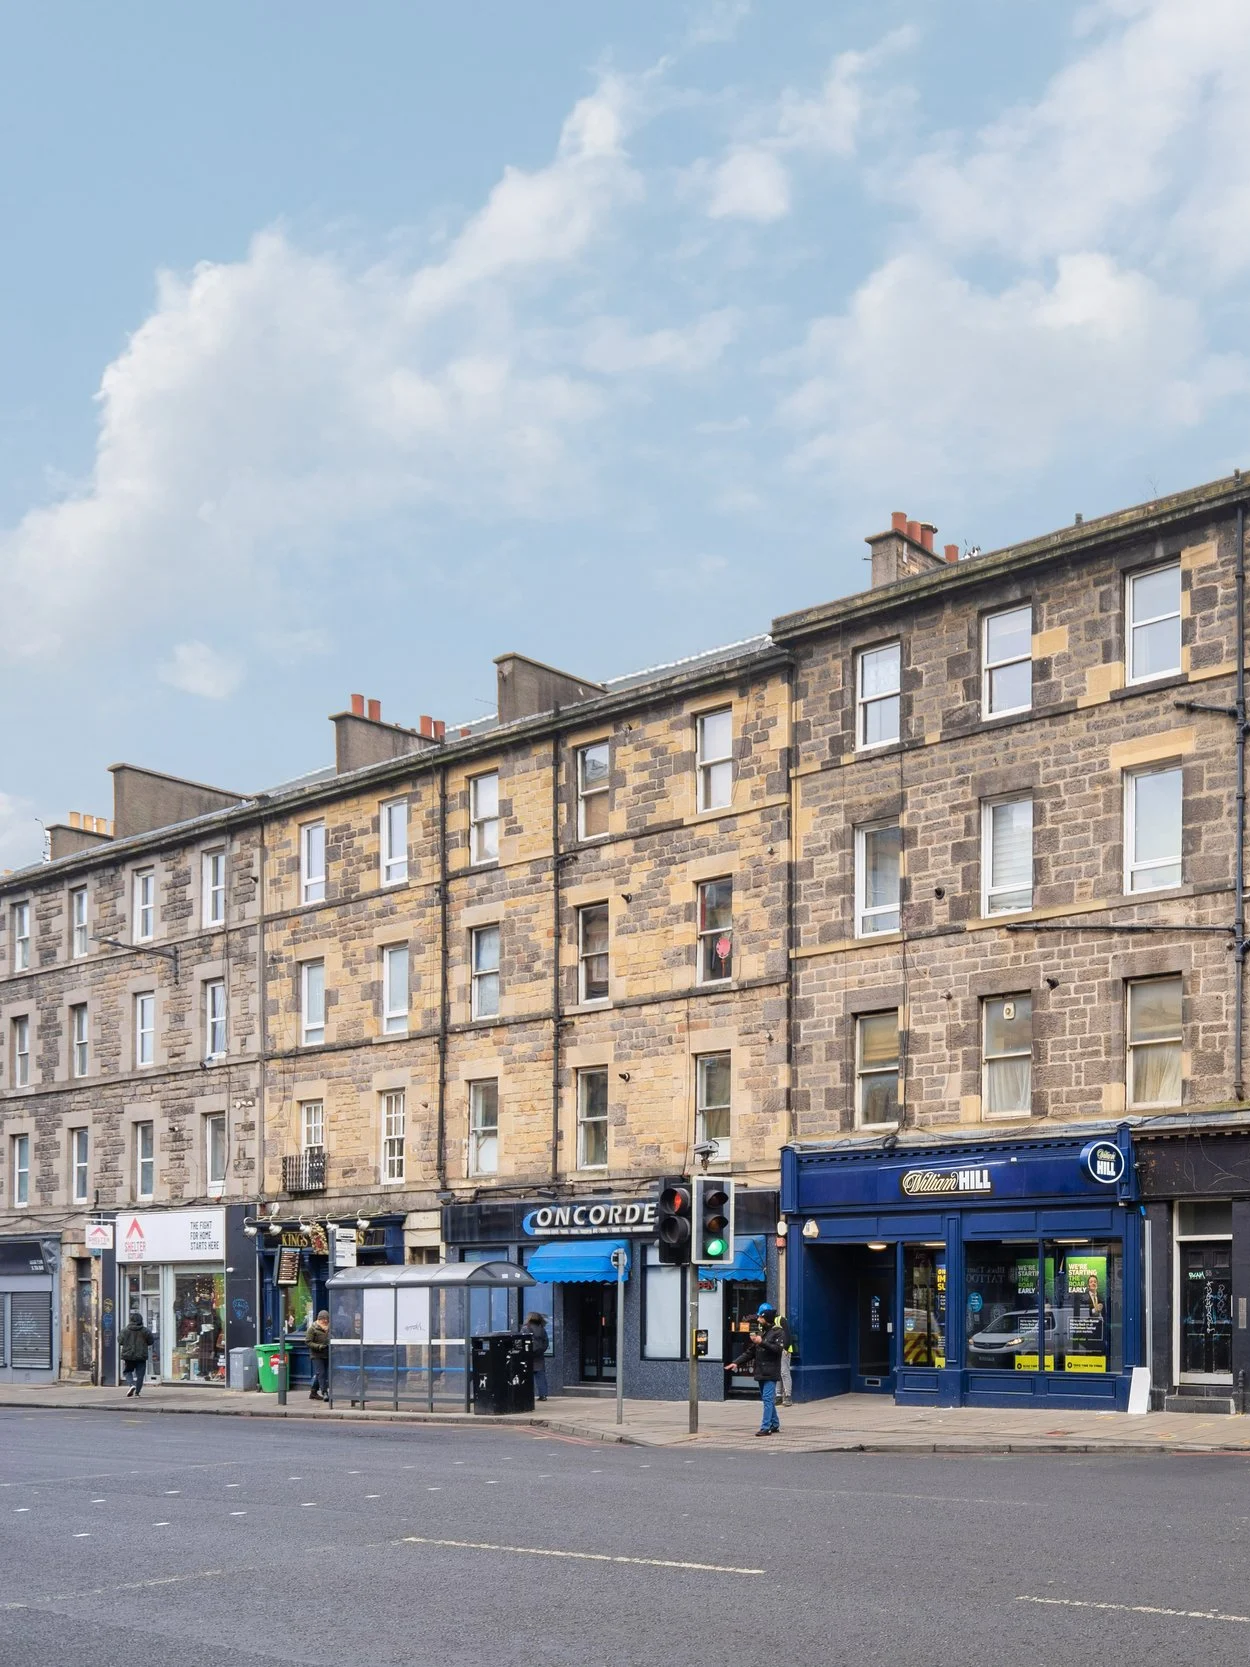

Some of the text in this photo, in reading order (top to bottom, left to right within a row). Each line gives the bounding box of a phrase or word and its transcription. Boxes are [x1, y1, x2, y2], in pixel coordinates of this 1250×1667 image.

[1097, 1161, 1115, 1176] HILL
[903, 1170, 991, 1194] William HILL
[200, 1221, 212, 1229] FIGHT
[190, 1231, 211, 1240] FOR HOME
[282, 1234, 308, 1247] KINGS
[125, 1242, 146, 1252] SHELTER
[190, 1241, 219, 1250] STARTS HERE
[697, 1281, 714, 1290] PEN
